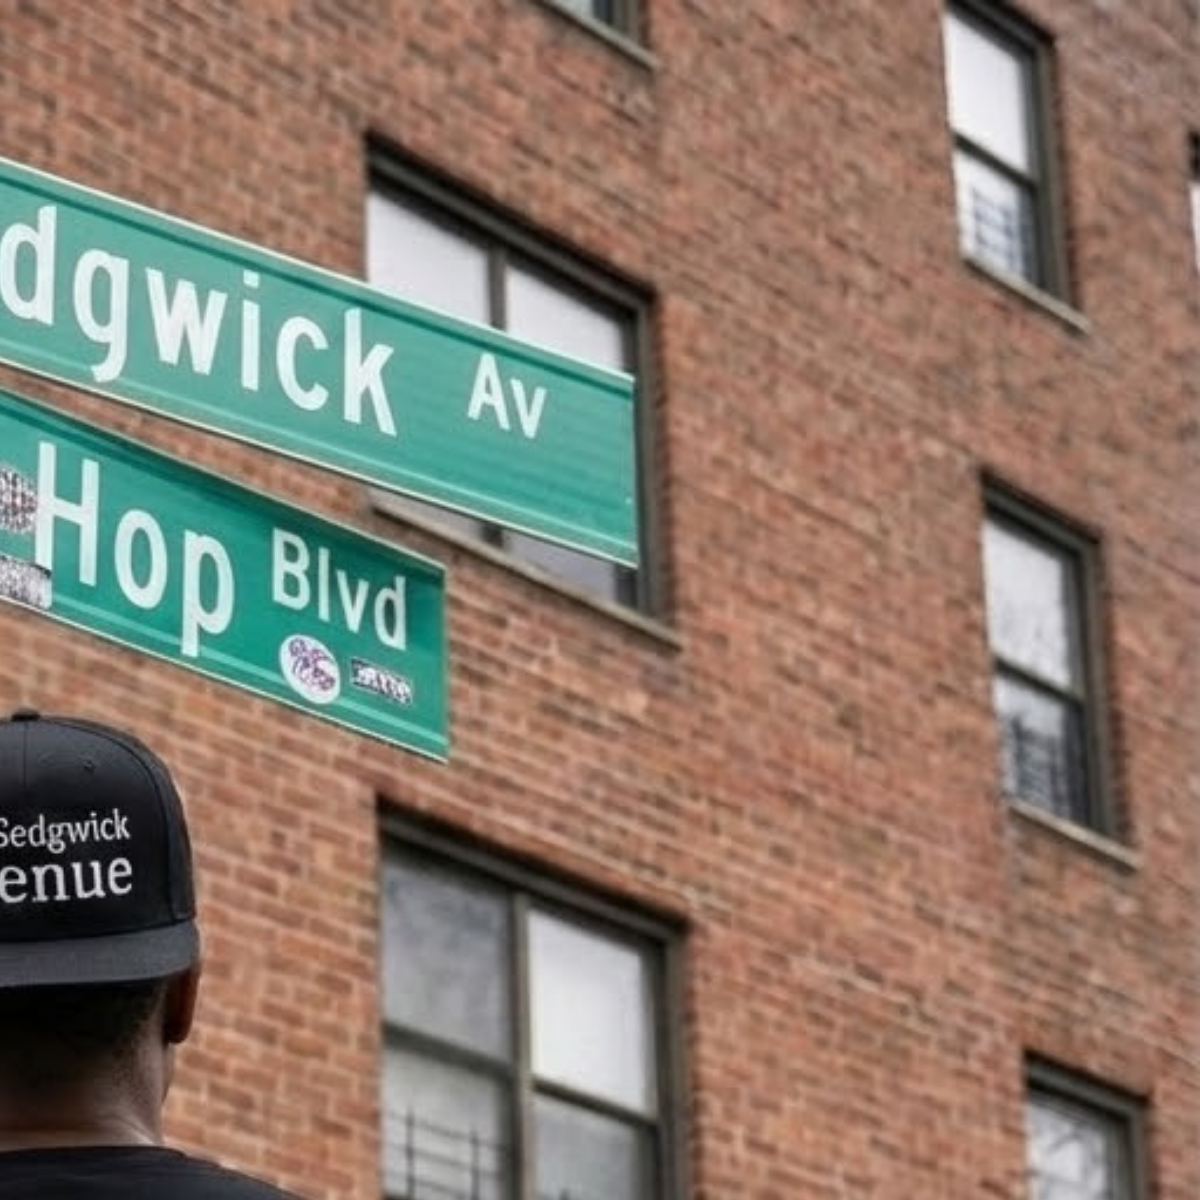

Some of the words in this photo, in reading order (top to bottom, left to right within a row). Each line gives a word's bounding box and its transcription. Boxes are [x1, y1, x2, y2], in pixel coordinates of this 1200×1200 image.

[467, 354, 548, 439] Av
[34, 441, 235, 657] Hop
[273, 527, 407, 651] Blvd
